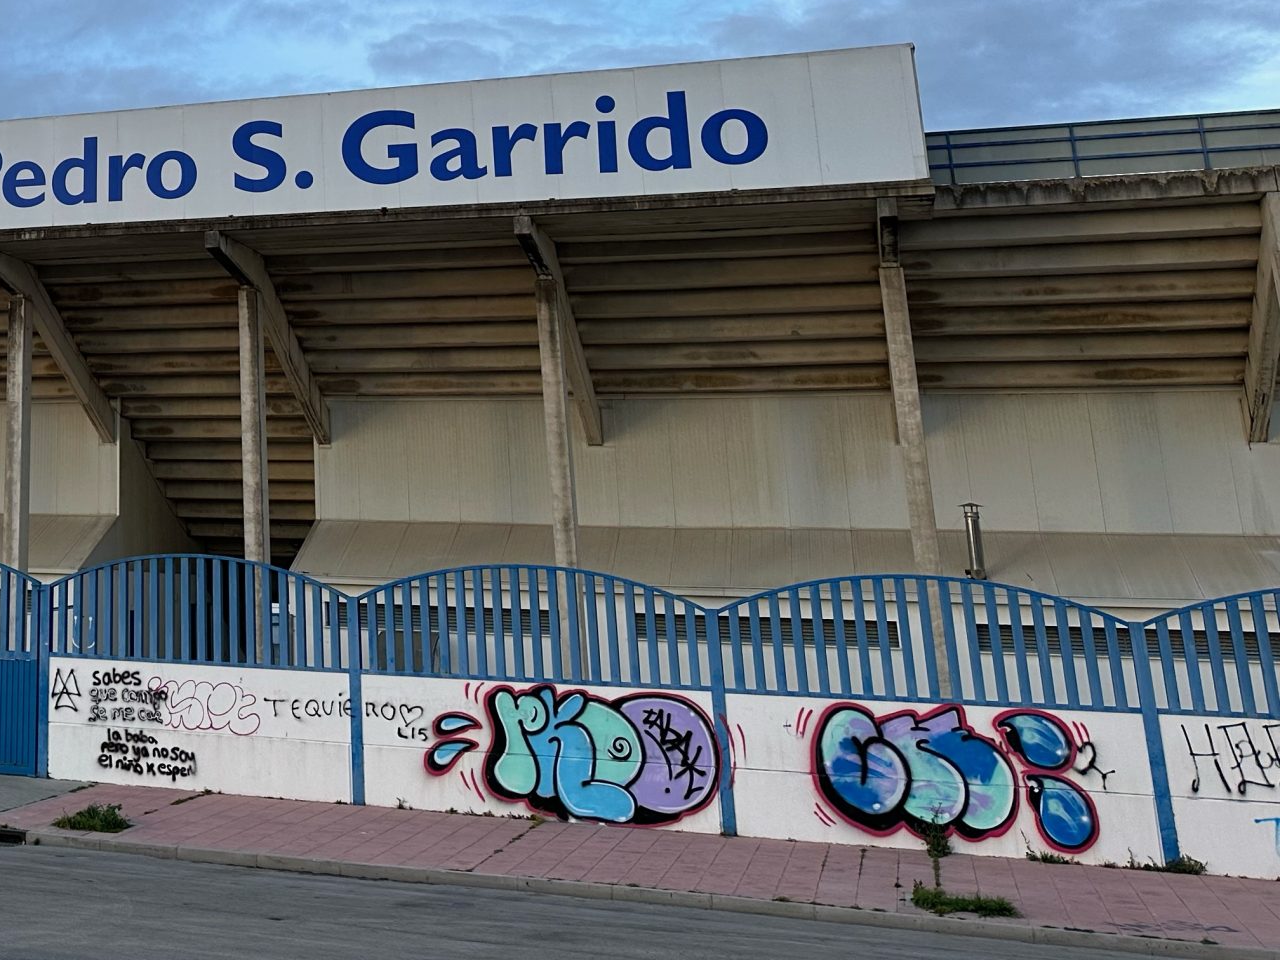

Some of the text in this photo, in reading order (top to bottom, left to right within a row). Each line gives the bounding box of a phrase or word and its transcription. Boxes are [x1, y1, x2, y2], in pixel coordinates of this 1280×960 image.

[232, 120, 313, 192] S.
[342, 91, 768, 185] Garrido
[92, 667, 142, 686] sabes
